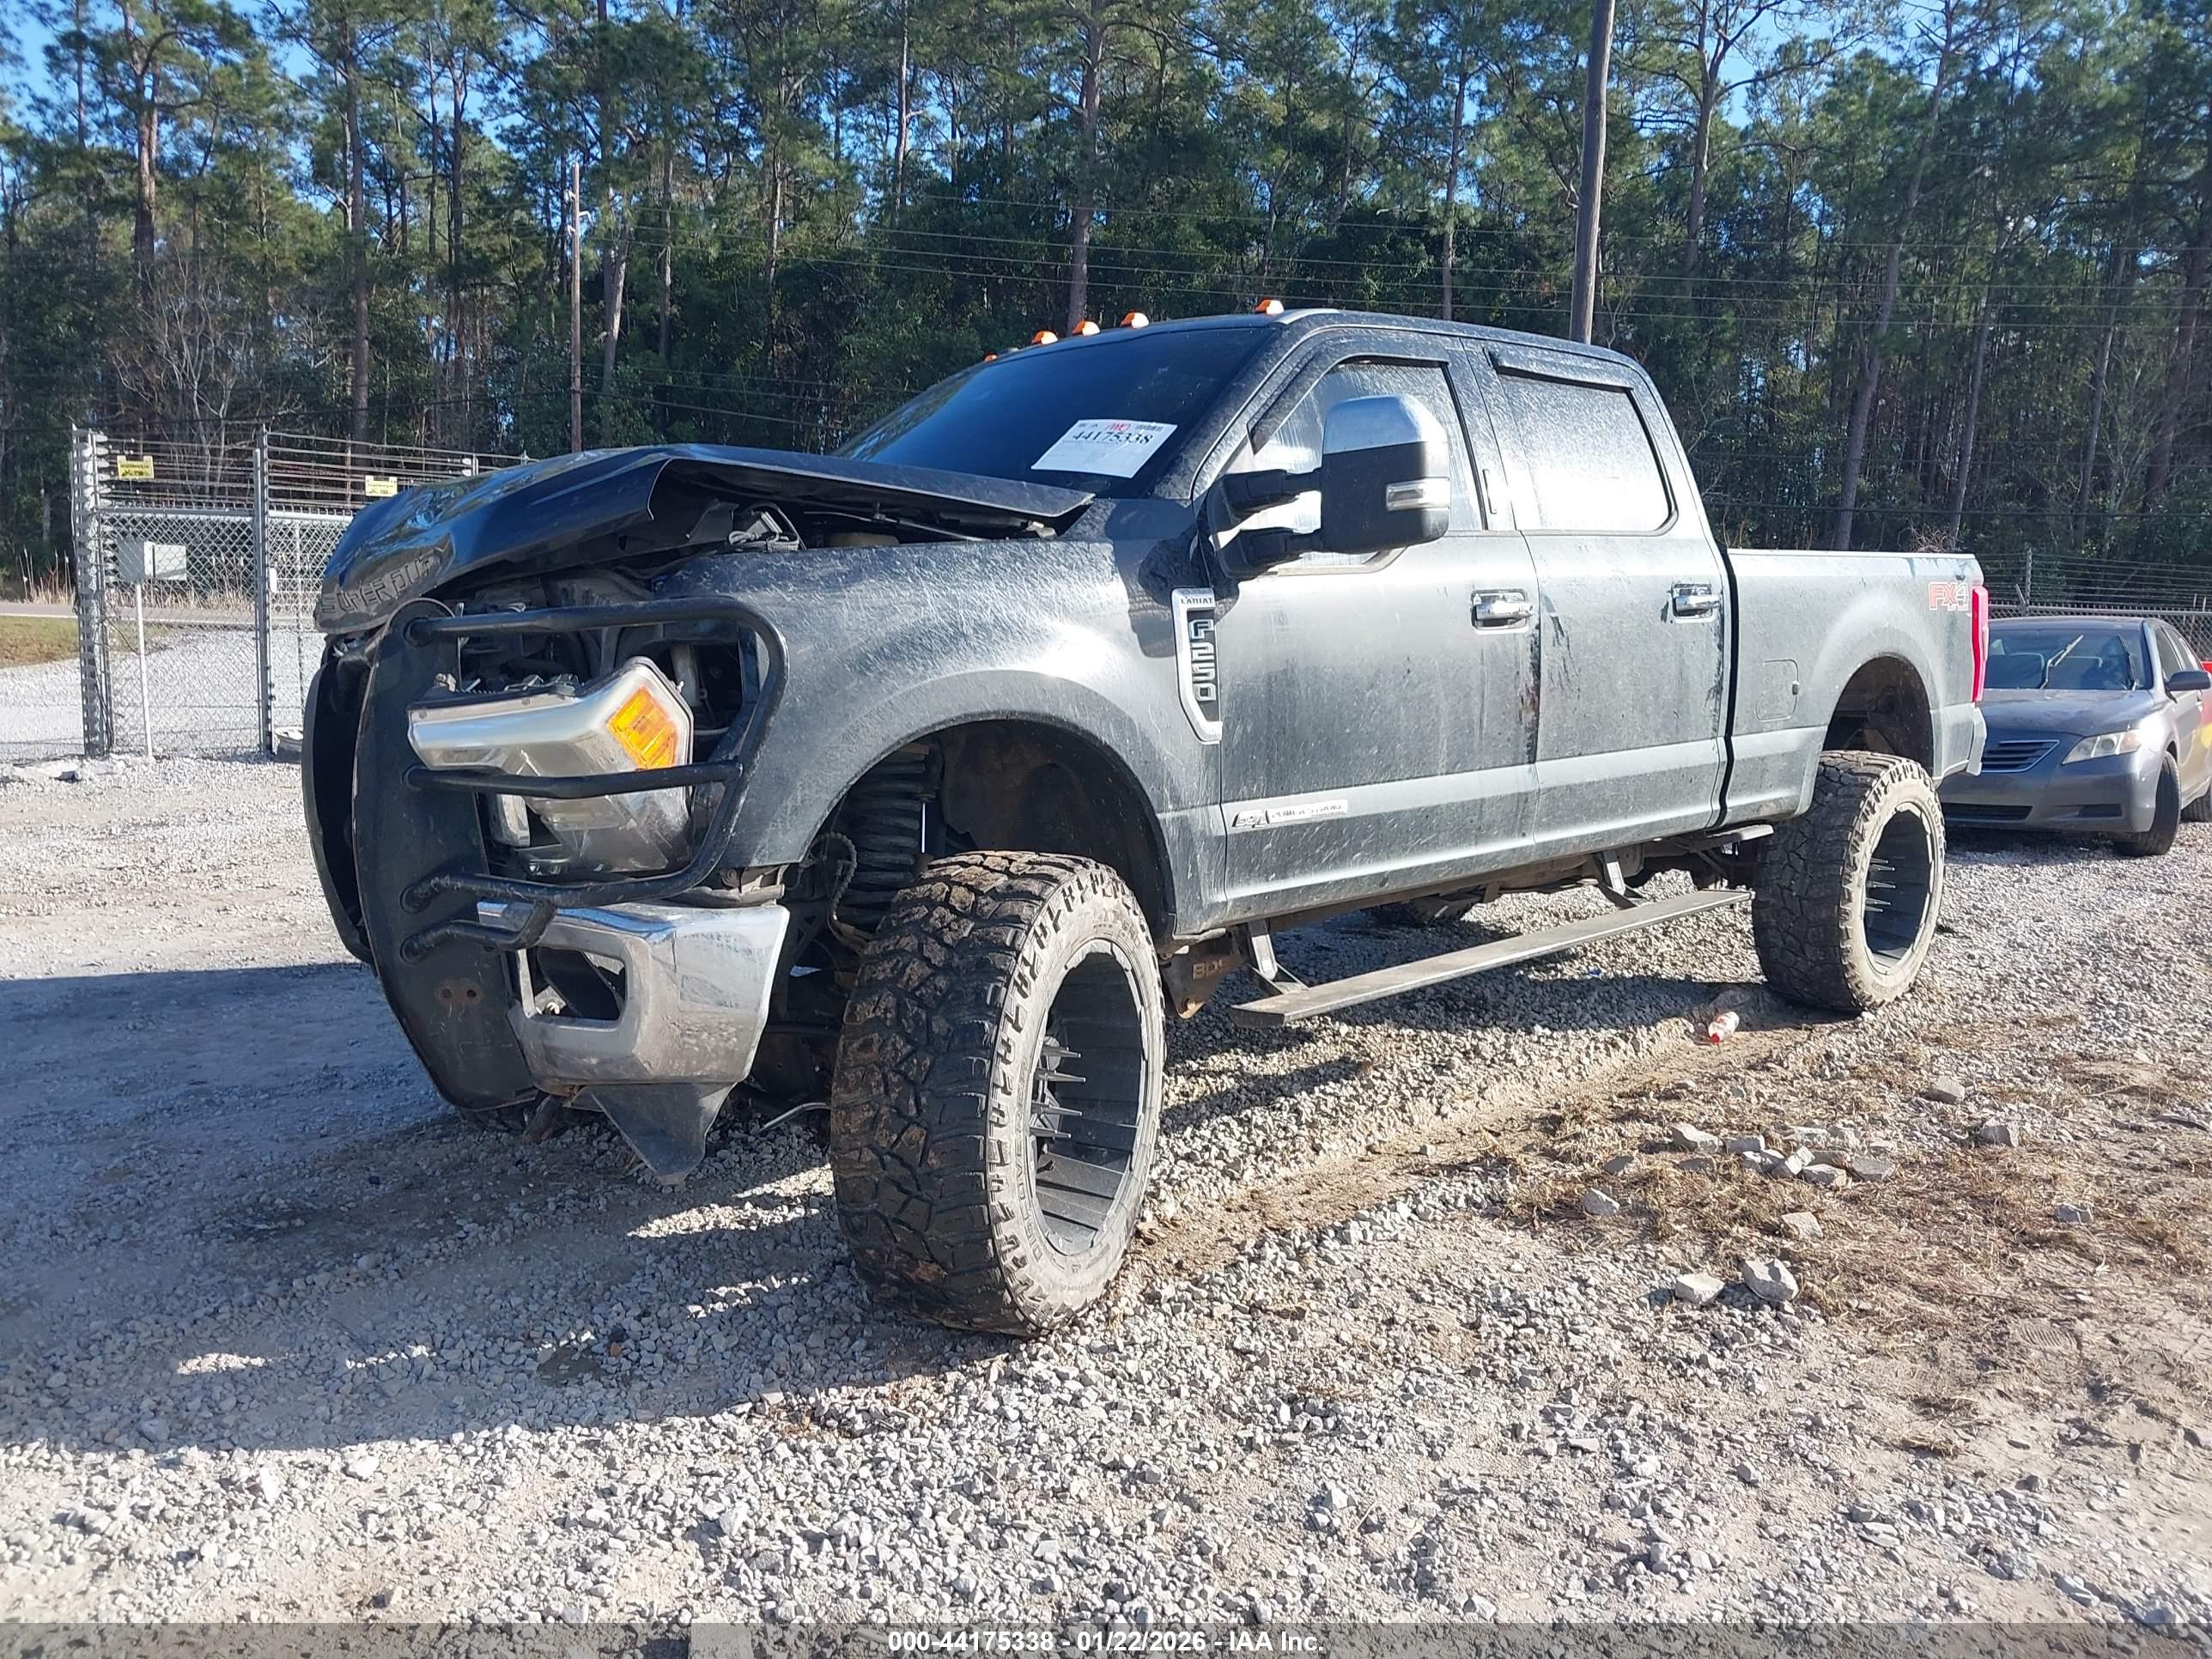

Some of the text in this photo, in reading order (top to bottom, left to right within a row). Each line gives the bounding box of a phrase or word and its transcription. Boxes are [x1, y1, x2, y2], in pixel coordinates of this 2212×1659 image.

[1073, 431, 1152, 443] 44175338
[320, 578, 391, 614] SUPER
[1928, 581, 1969, 611] FX4
[1188, 618, 1217, 702] F250
[1015, 1056, 1043, 1263] DISCOVERER
